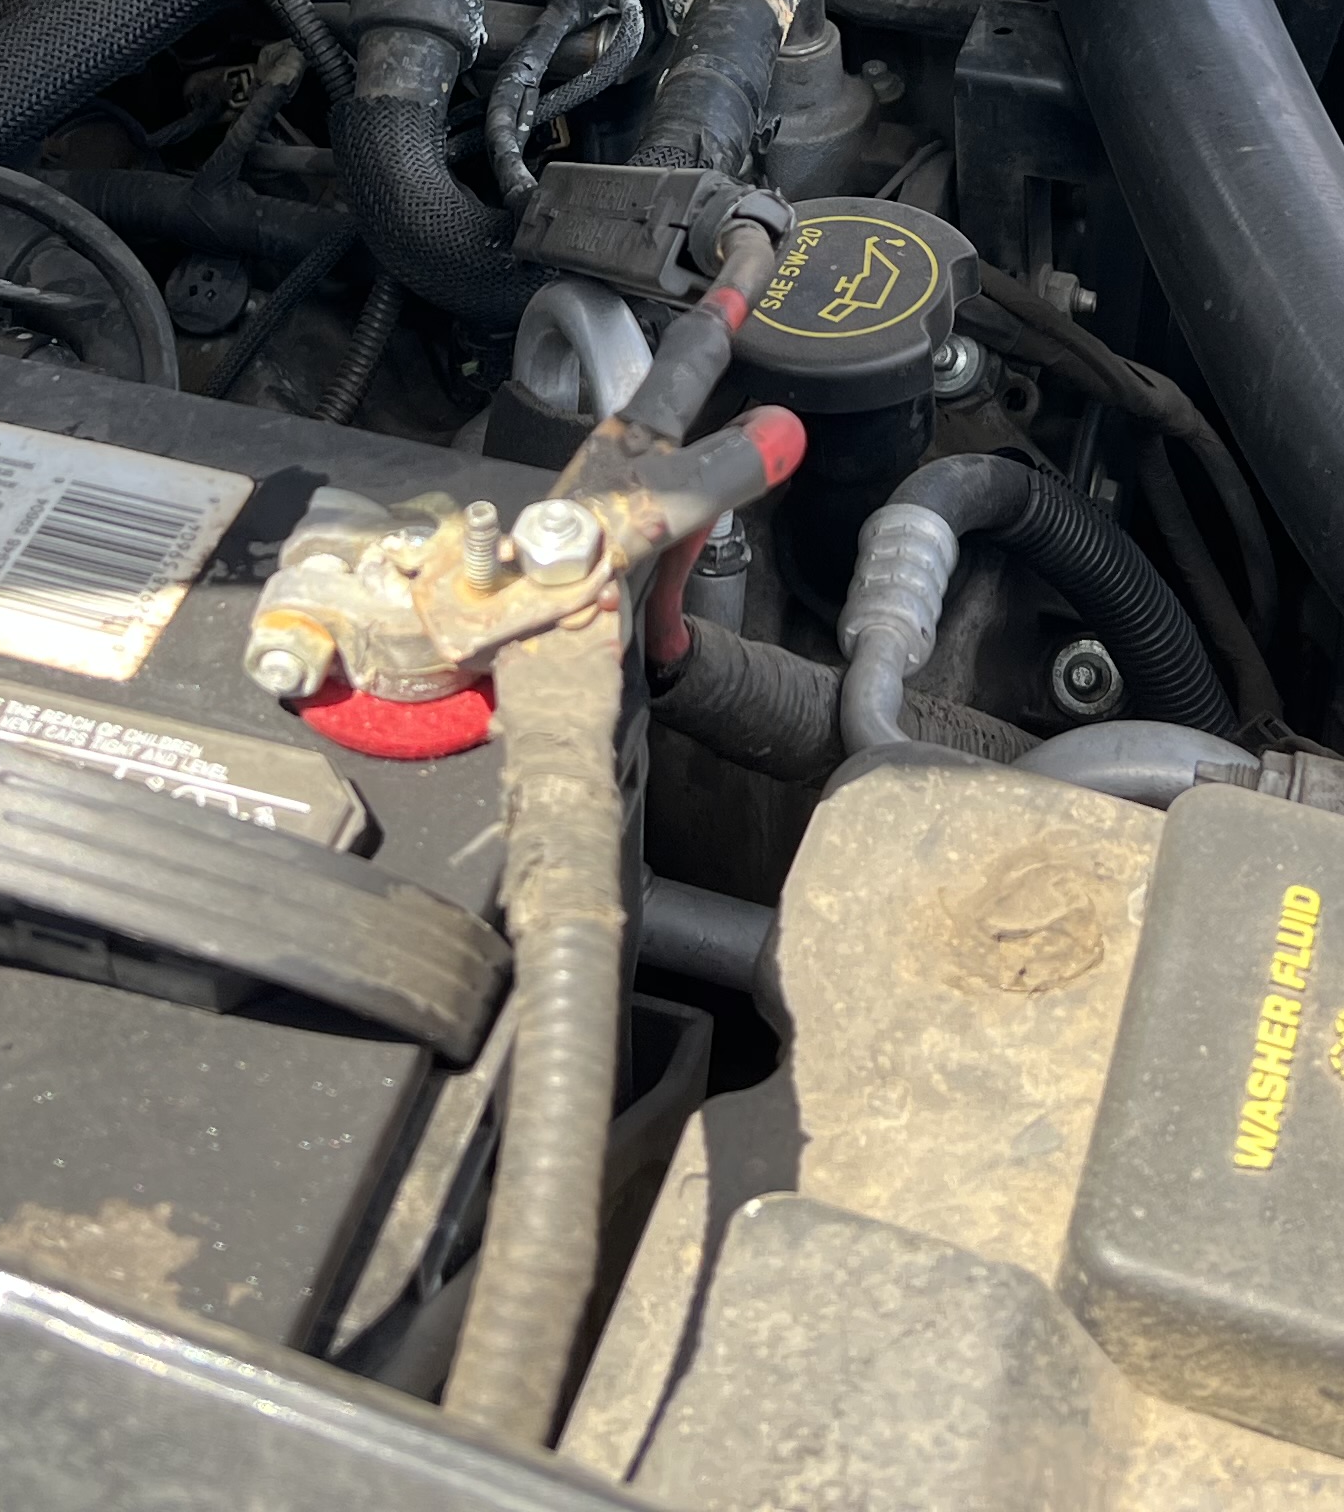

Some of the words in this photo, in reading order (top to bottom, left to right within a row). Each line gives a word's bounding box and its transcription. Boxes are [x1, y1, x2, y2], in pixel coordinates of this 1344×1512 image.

[759, 278, 794, 310] SAE
[778, 227, 823, 277] 5W-20
[162, 523, 203, 570] 59604
[6, 699, 42, 720] THE
[38, 708, 97, 734] REACH
[94, 722, 124, 739] OF
[122, 728, 204, 759] CHILDREN
[42, 724, 89, 748] CAPS
[88, 735, 143, 759] TIGHT
[137, 747, 180, 769] AND
[1232, 992, 1303, 1170] WASHER
[1268, 884, 1322, 991] FLUID
